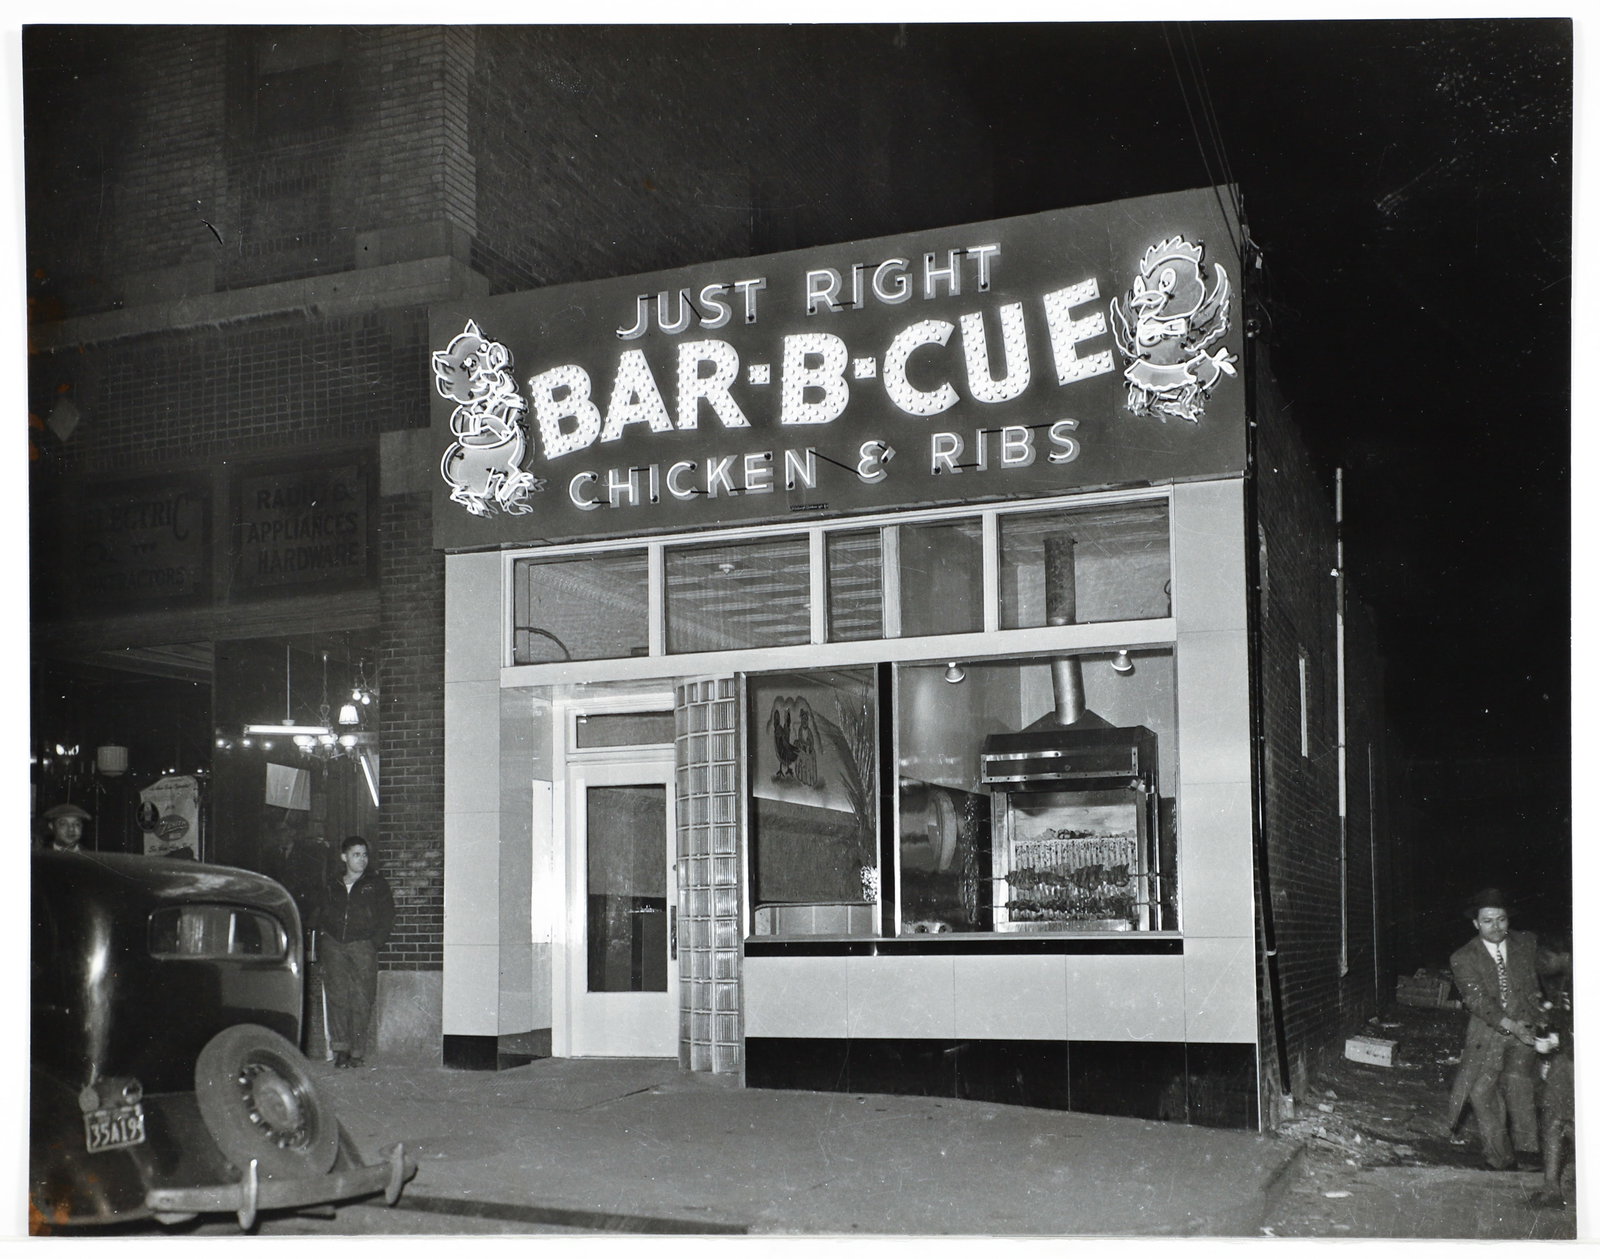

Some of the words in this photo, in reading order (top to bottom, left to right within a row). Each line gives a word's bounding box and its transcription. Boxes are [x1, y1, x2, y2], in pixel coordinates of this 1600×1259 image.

[616, 277, 766, 340] JUST
[805, 242, 1001, 316] RIGHT
[528, 278, 1115, 460] BAR-B-CUE
[568, 447, 817, 511] CHICKEN
[857, 439, 896, 484] &
[931, 418, 1080, 475] RIBS
[247, 511, 359, 543] APPLIANCES
[257, 542, 360, 575] HARDWARE
